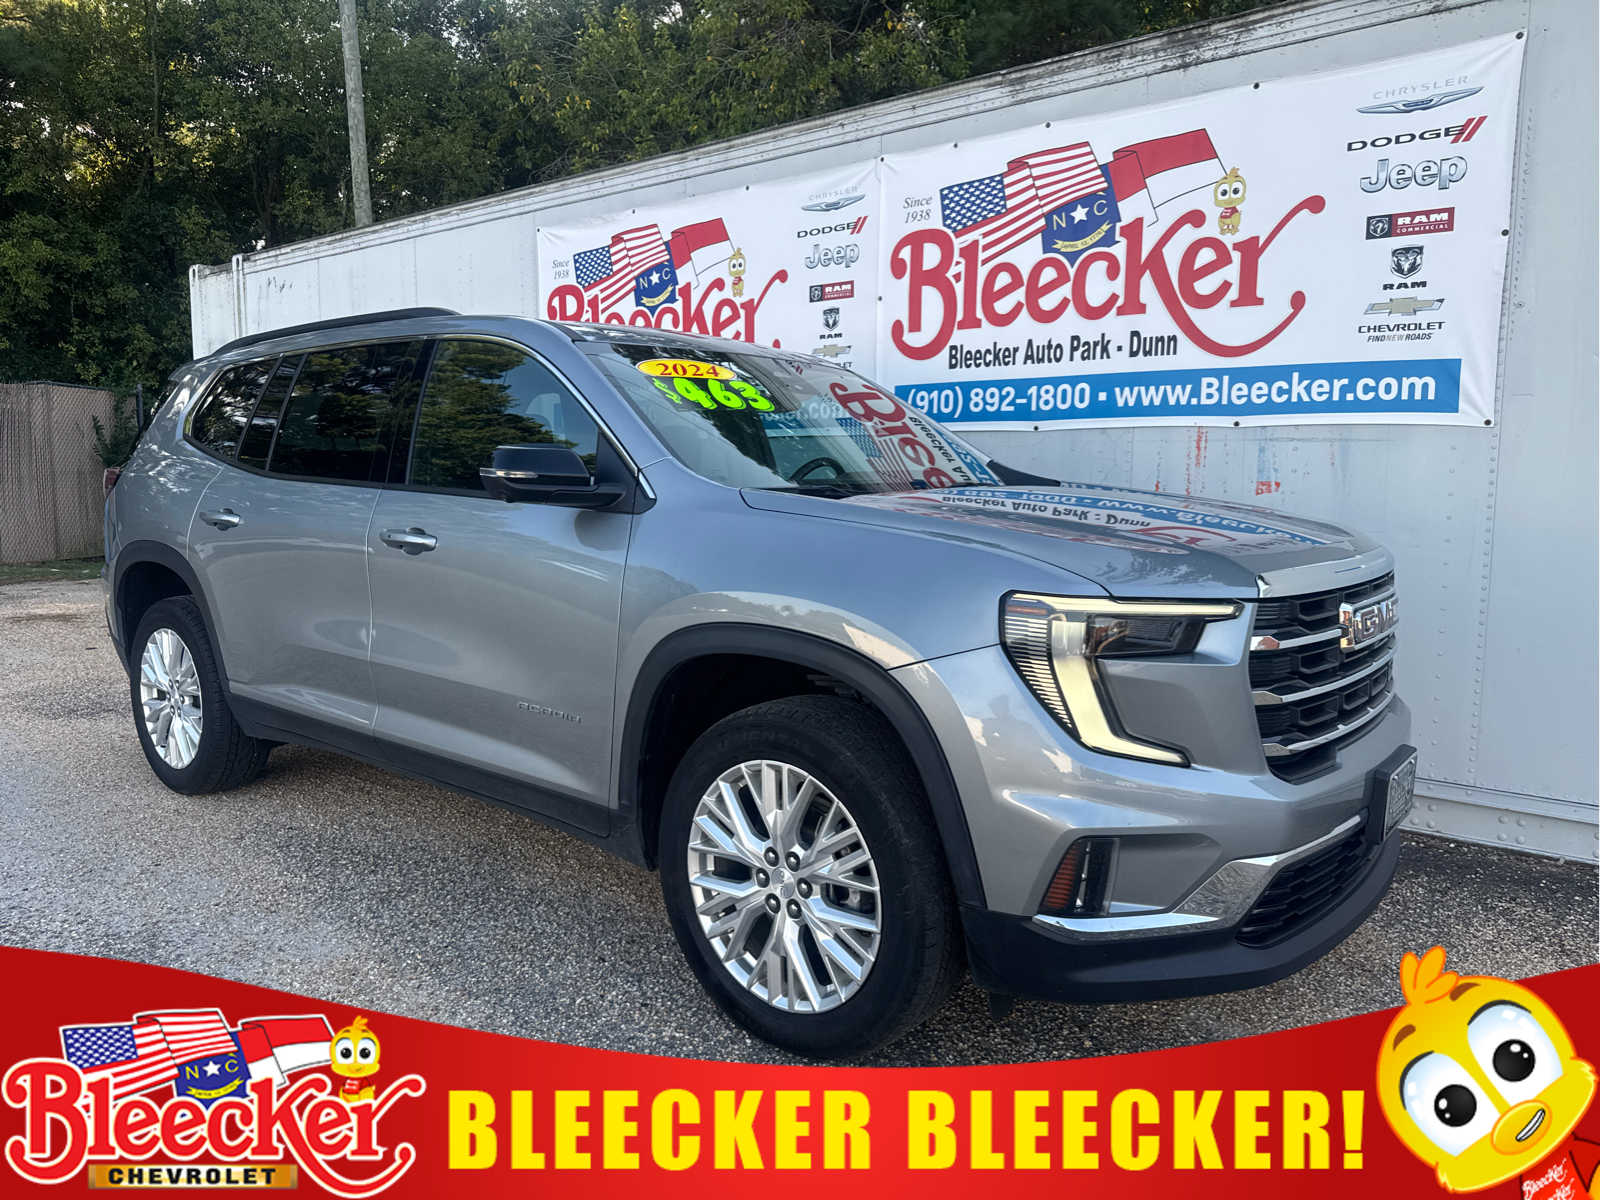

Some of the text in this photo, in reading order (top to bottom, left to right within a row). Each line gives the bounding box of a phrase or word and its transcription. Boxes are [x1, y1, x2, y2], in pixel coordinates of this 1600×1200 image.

[1372, 75, 1469, 100] CHRYSLER
[1346, 124, 1465, 152] DODGE
[1359, 155, 1468, 194] Jeep
[902, 196, 933, 209] Since
[904, 208, 932, 224] 1938
[1052, 199, 1108, 231] N C
[1396, 212, 1449, 226] RAM
[796, 221, 858, 239] DODGE
[1396, 223, 1449, 234] COMMERCIAL
[804, 243, 860, 270] Jeep
[639, 267, 672, 290] N C
[1382, 280, 1428, 291] RAM
[824, 283, 852, 294] RAM
[818, 332, 843, 340] RAM
[1357, 321, 1447, 334] CHEVROLET
[948, 341, 1019, 370] Bleecker
[1023, 337, 1064, 366] Auto
[1069, 333, 1112, 362] Park
[1128, 330, 1178, 358] Dunn
[655, 362, 720, 378] 2024
[907, 371, 1437, 418] (910) 892-1800 www.Bleecker.com
